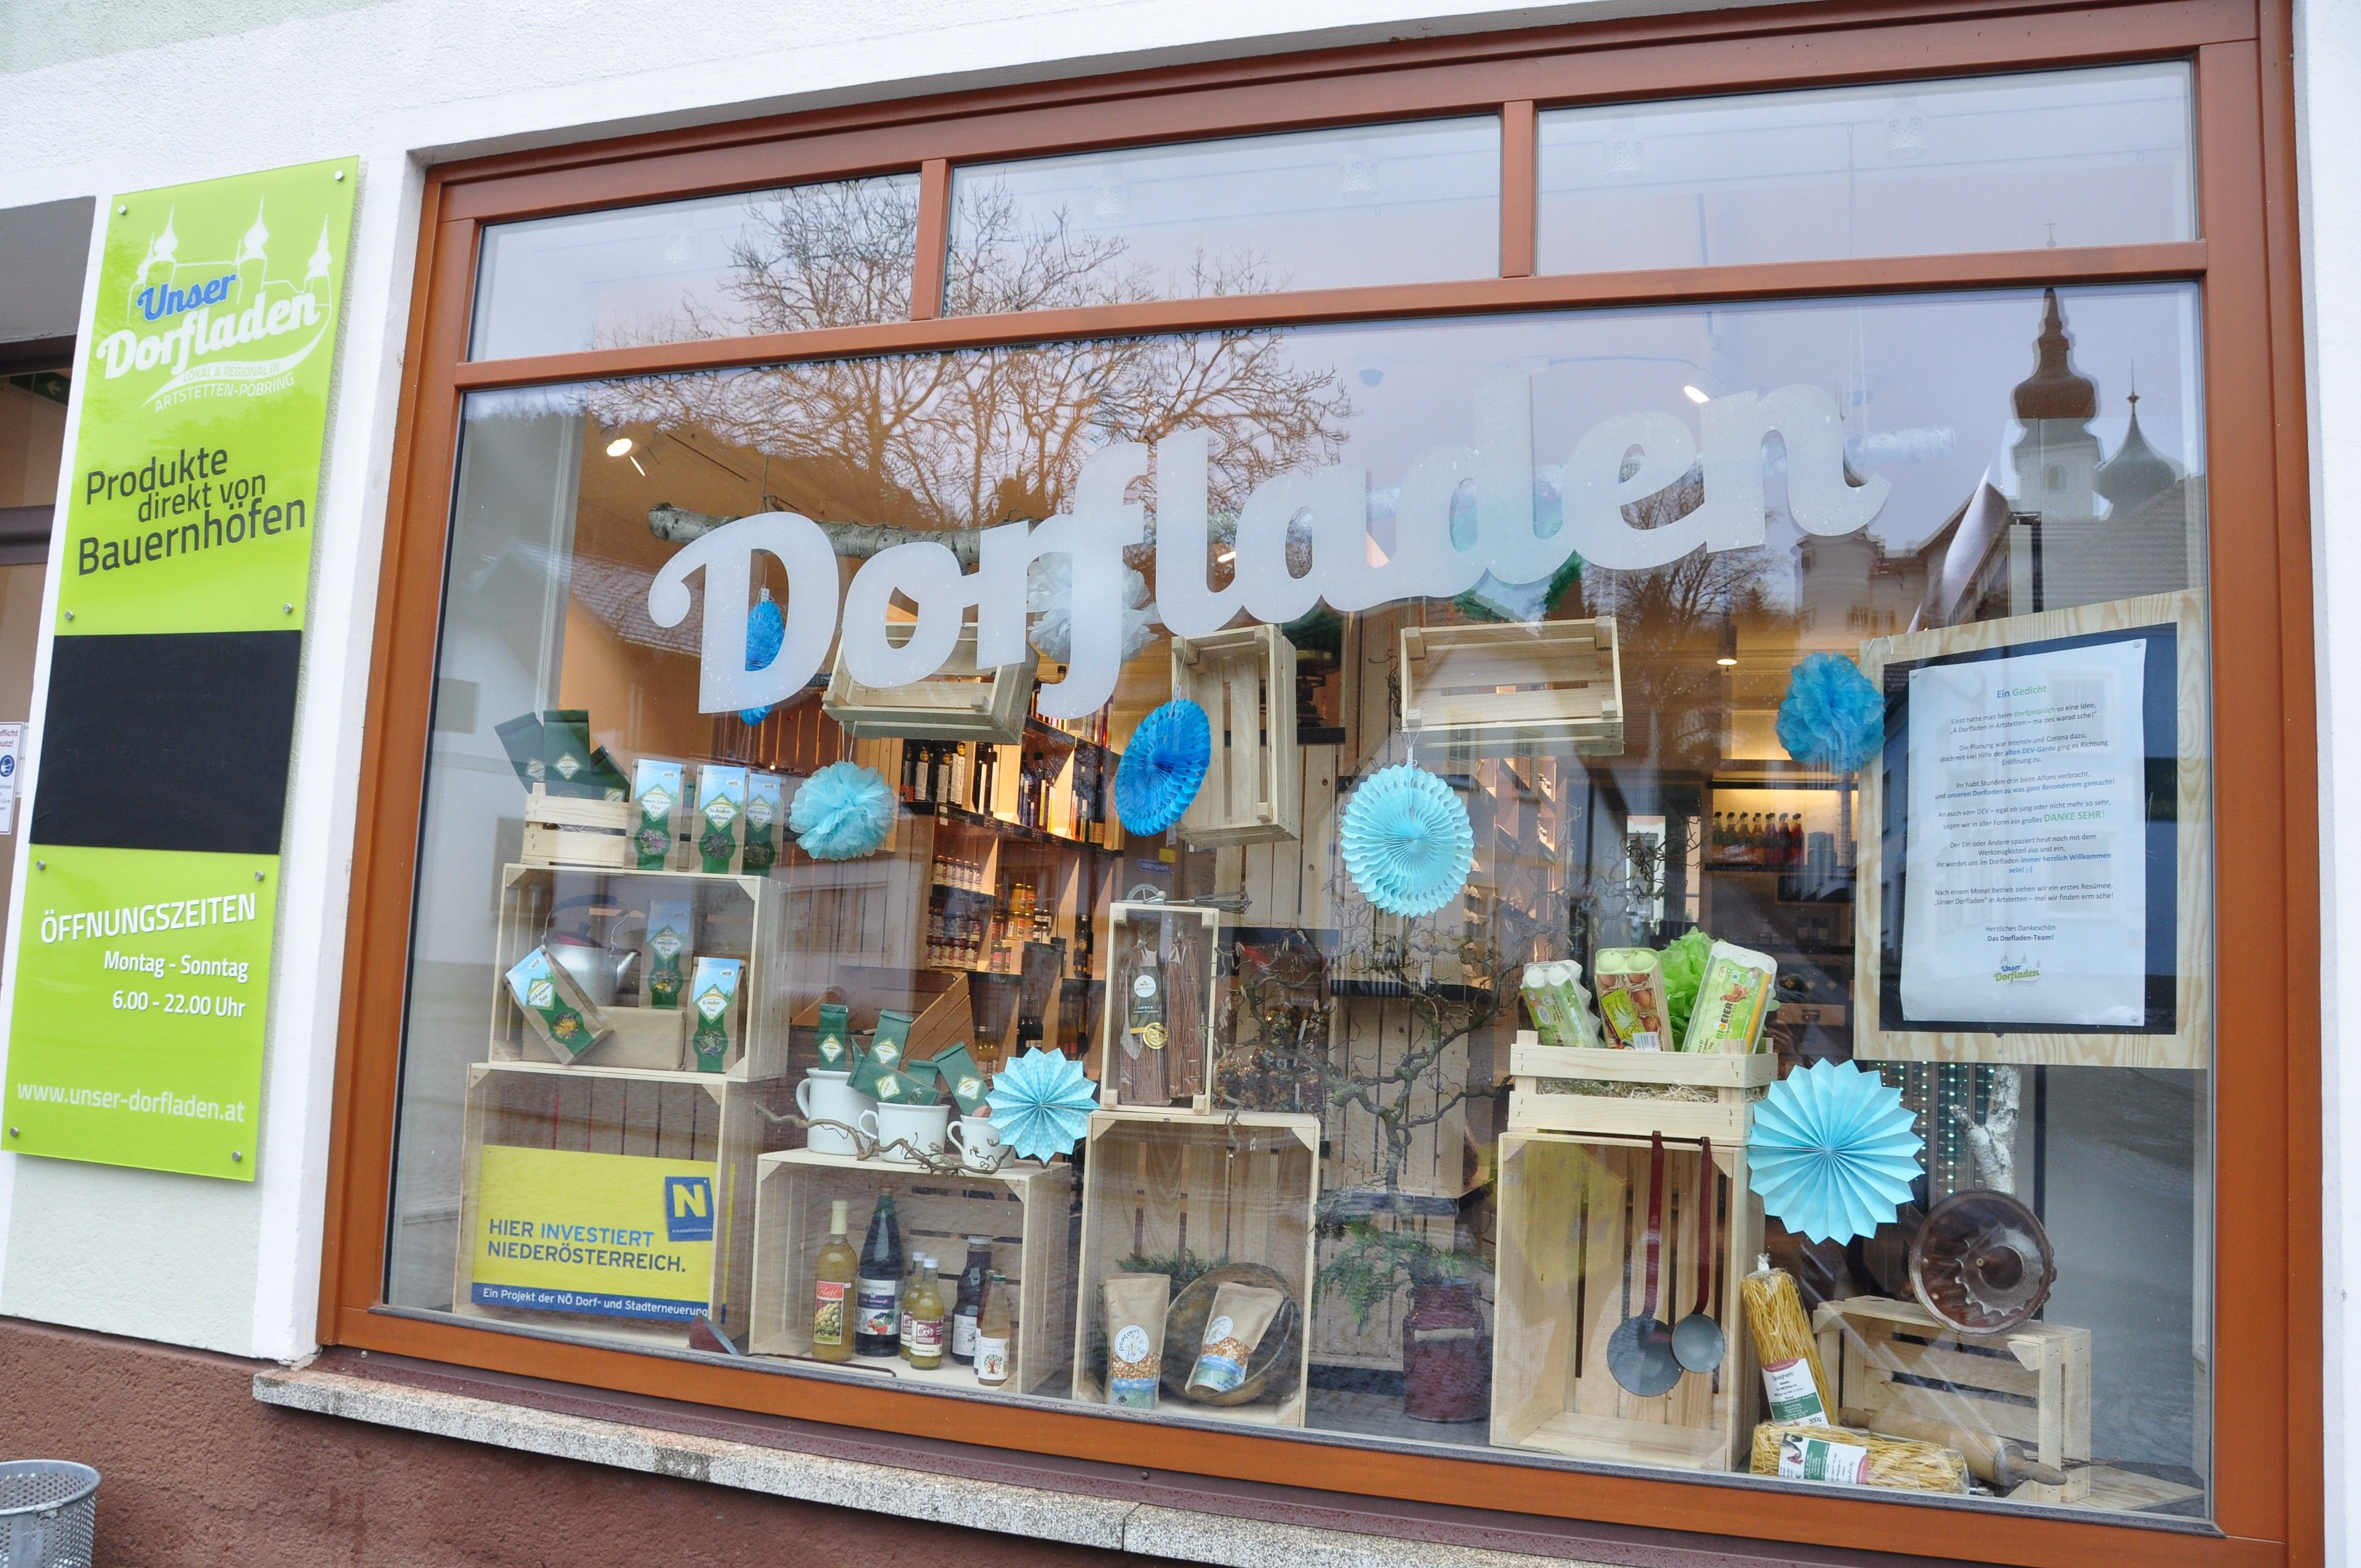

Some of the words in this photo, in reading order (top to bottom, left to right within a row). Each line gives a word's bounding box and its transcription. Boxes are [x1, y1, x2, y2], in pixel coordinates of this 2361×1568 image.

[137, 274, 237, 322] Unser
[96, 291, 321, 379] Dorfladen
[183, 367, 213, 382] LOKAL
[214, 366, 221, 377] &
[223, 363, 269, 377] REGIONAL
[269, 362, 280, 373] IN
[155, 372, 295, 413] ARTSTETTEN-PÖBRING
[86, 447, 227, 505] Produkte
[138, 482, 212, 522] direkt
[220, 473, 266, 504] von
[78, 497, 306, 576] Bauernhöfen
[649, 370, 1890, 718] Dorfladen
[1996, 690, 2010, 698] Ein
[2012, 685, 2047, 696] Gedicht
[1970, 742, 1994, 751] Planung
[2069, 733, 2087, 741] dazu,
[2080, 740, 2108, 749] Richtung
[1972, 788, 2003, 796] Dorfladen
[2042, 781, 2082, 790] Besonderem
[2083, 779, 2114, 788] gemacht!
[2043, 813, 2075, 822] DANKE
[2077, 812, 2104, 820] SEHR!
[2010, 837, 2035, 846] spaziert
[2069, 852, 2111, 861] Willkommen
[41, 892, 255, 944] ÖFFNUNGSZEITEN
[104, 951, 165, 978] Montag
[180, 955, 249, 983] Sonntag
[1994, 970, 2039, 982] Dorfladen
[112, 990, 149, 1011] 6.00
[164, 994, 211, 1016] 22.00
[215, 996, 246, 1017] Uhr
[17, 1082, 245, 1123] www.unser-dorfladen.at
[673, 1184, 706, 1217] N
[489, 1218, 534, 1238] HIER
[541, 1223, 655, 1248] INVESTIERT
[488, 1240, 686, 1273] NIEDERÖSTERREICH.
[483, 1288, 498, 1298] Ein
[501, 1289, 536, 1304] Projekt
[538, 1292, 555, 1303] der
[557, 1293, 573, 1305] NÖ
[575, 1296, 602, 1308] Dorf-
[603, 1299, 622, 1309] und
[625, 1300, 709, 1318] Stadterneuerung
